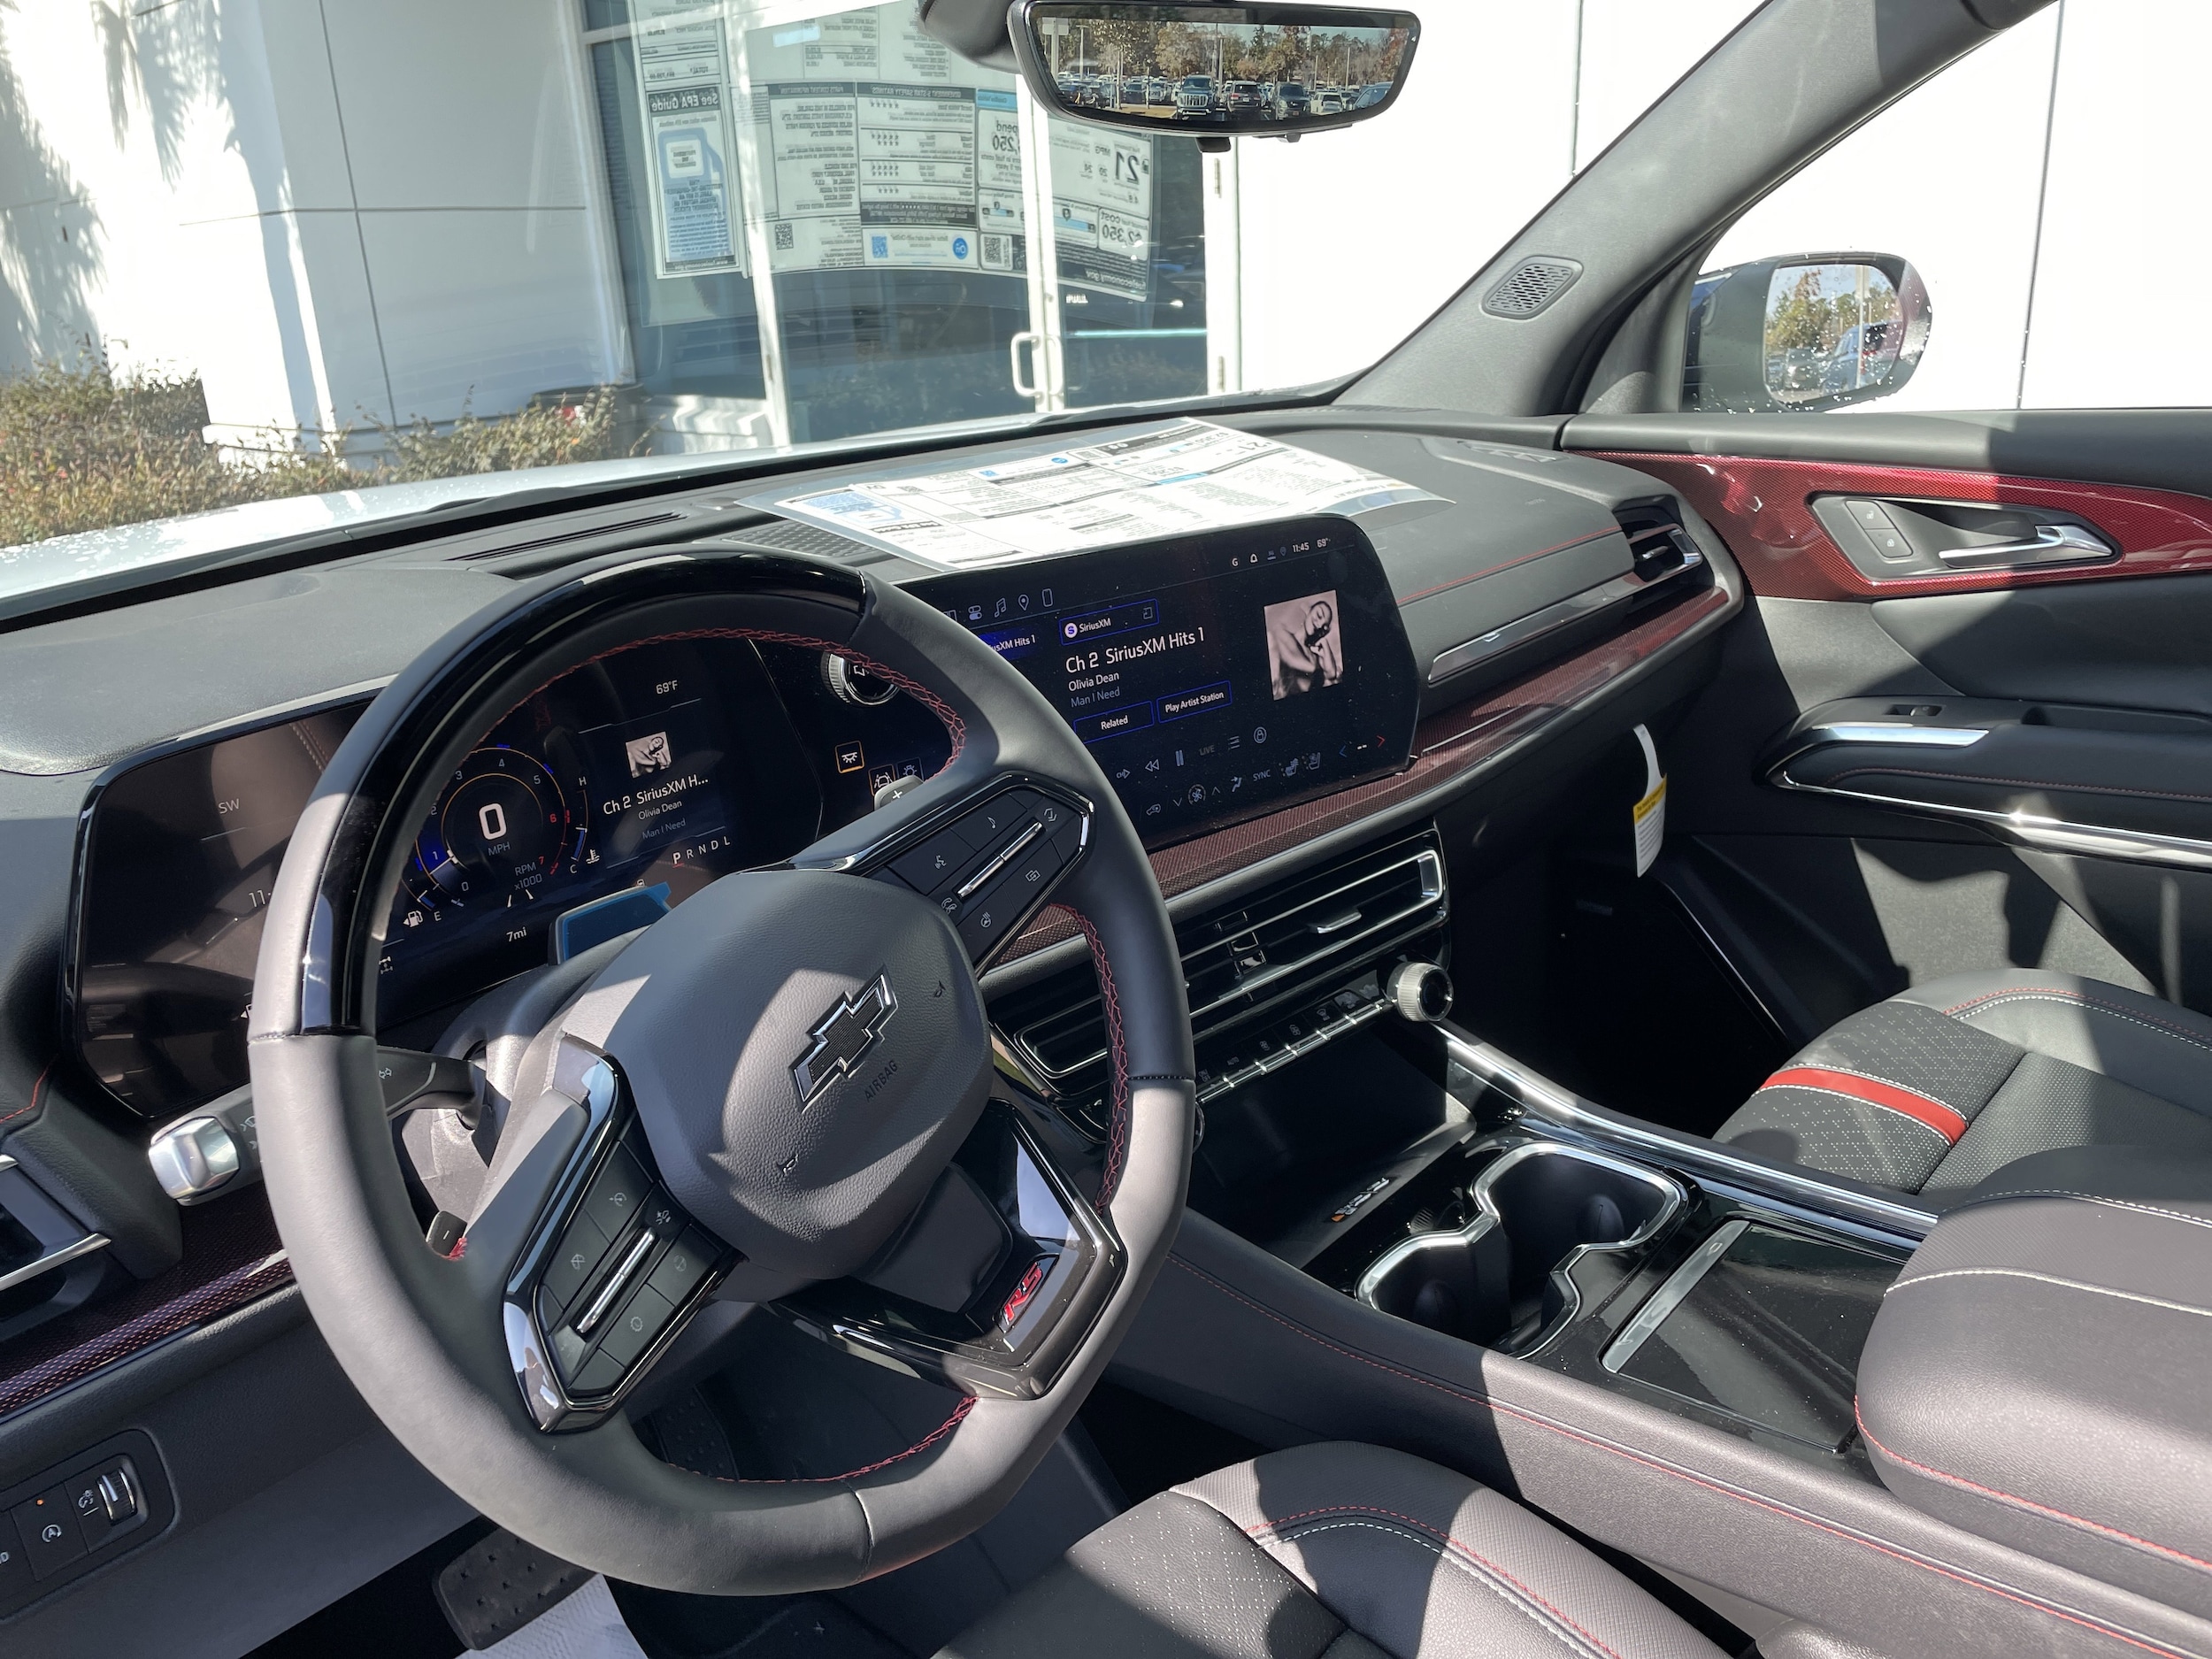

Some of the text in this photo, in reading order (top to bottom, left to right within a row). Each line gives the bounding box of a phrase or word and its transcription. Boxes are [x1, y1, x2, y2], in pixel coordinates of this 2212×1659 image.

[1292, 541, 1310, 553] 11:45
[1079, 618, 1111, 634] SiriusXM
[1014, 636, 1031, 647] Hits
[1031, 634, 1036, 643] 1
[1065, 626, 1205, 674] Ch 2 SiriusXM Hits 1
[656, 680, 678, 695] 69°F
[1068, 672, 1120, 692] Olivia Dean
[1071, 695, 1091, 708] Man
[1096, 686, 1121, 702] Need
[1164, 691, 1225, 713] Play Artist Station
[1100, 715, 1129, 731] Related
[1199, 745, 1215, 756] LIVE
[498, 758, 505, 768] 4
[455, 770, 463, 780] 3
[534, 774, 541, 785] 5
[579, 776, 588, 786] H
[1252, 769, 1271, 781] SYNC
[603, 799, 621, 815] Ch
[622, 795, 632, 810] 2
[636, 778, 687, 805] SiriusXM
[218, 797, 241, 815] SW
[430, 803, 438, 816] 2
[638, 800, 682, 821] Olivia Dean
[479, 803, 507, 841] 0
[549, 813, 557, 824] 6
[641, 827, 660, 840] Man
[664, 818, 687, 833] Need
[432, 850, 439, 861] 1
[488, 841, 511, 856] MPH
[672, 835, 731, 864] P R N D L
[538, 856, 545, 865] 7
[514, 861, 537, 876] RPM
[570, 864, 578, 874] C
[461, 880, 469, 892] 0
[514, 873, 542, 891] x1000
[434, 910, 442, 922] E
[505, 926, 527, 942] 7mi
[864, 1058, 899, 1102] AIRBAG
[1003, 1261, 1043, 1324] RS
